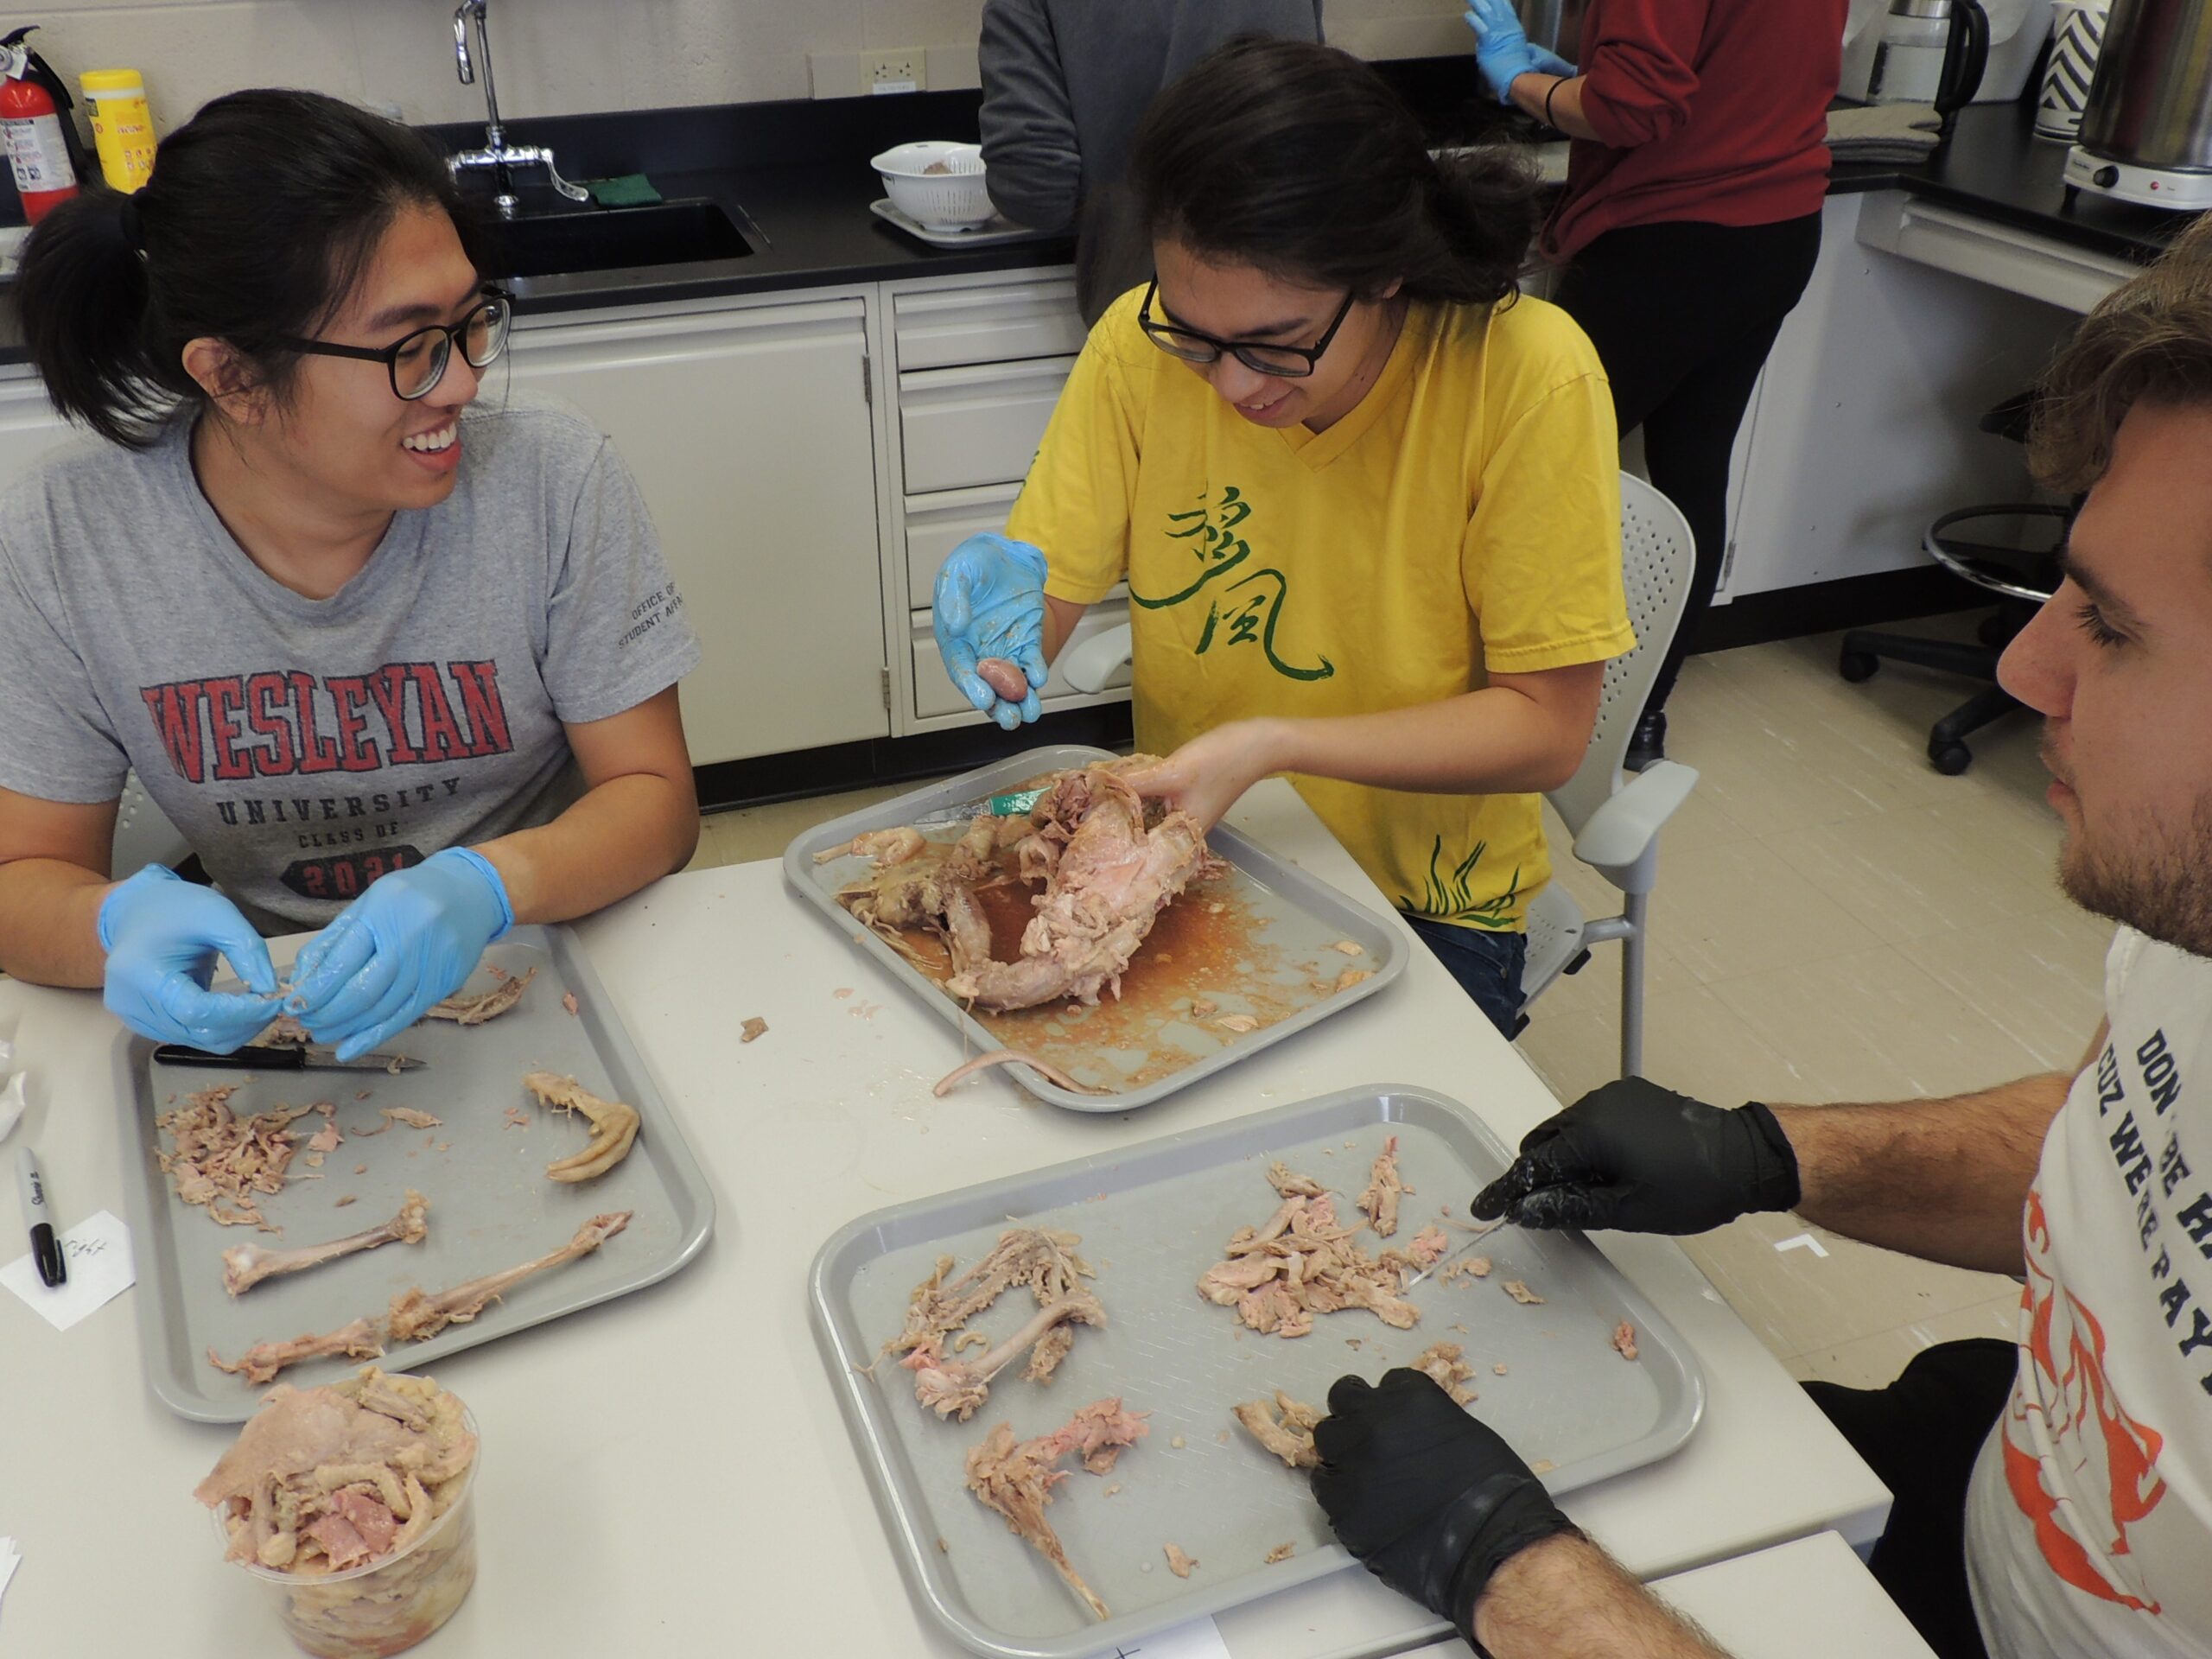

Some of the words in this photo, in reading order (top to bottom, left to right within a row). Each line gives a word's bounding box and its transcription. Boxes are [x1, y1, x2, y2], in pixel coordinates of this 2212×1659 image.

[618, 613, 662, 650] STUDENT
[665, 592, 684, 617] AFFA
[632, 591, 665, 620] OFFICE
[140, 659, 515, 784] WESLEYAN
[217, 778, 461, 826] UNIVERSITY
[298, 828, 365, 849] CLASS
[375, 821, 400, 838] OF
[2097, 1042, 2126, 1118] CUZ
